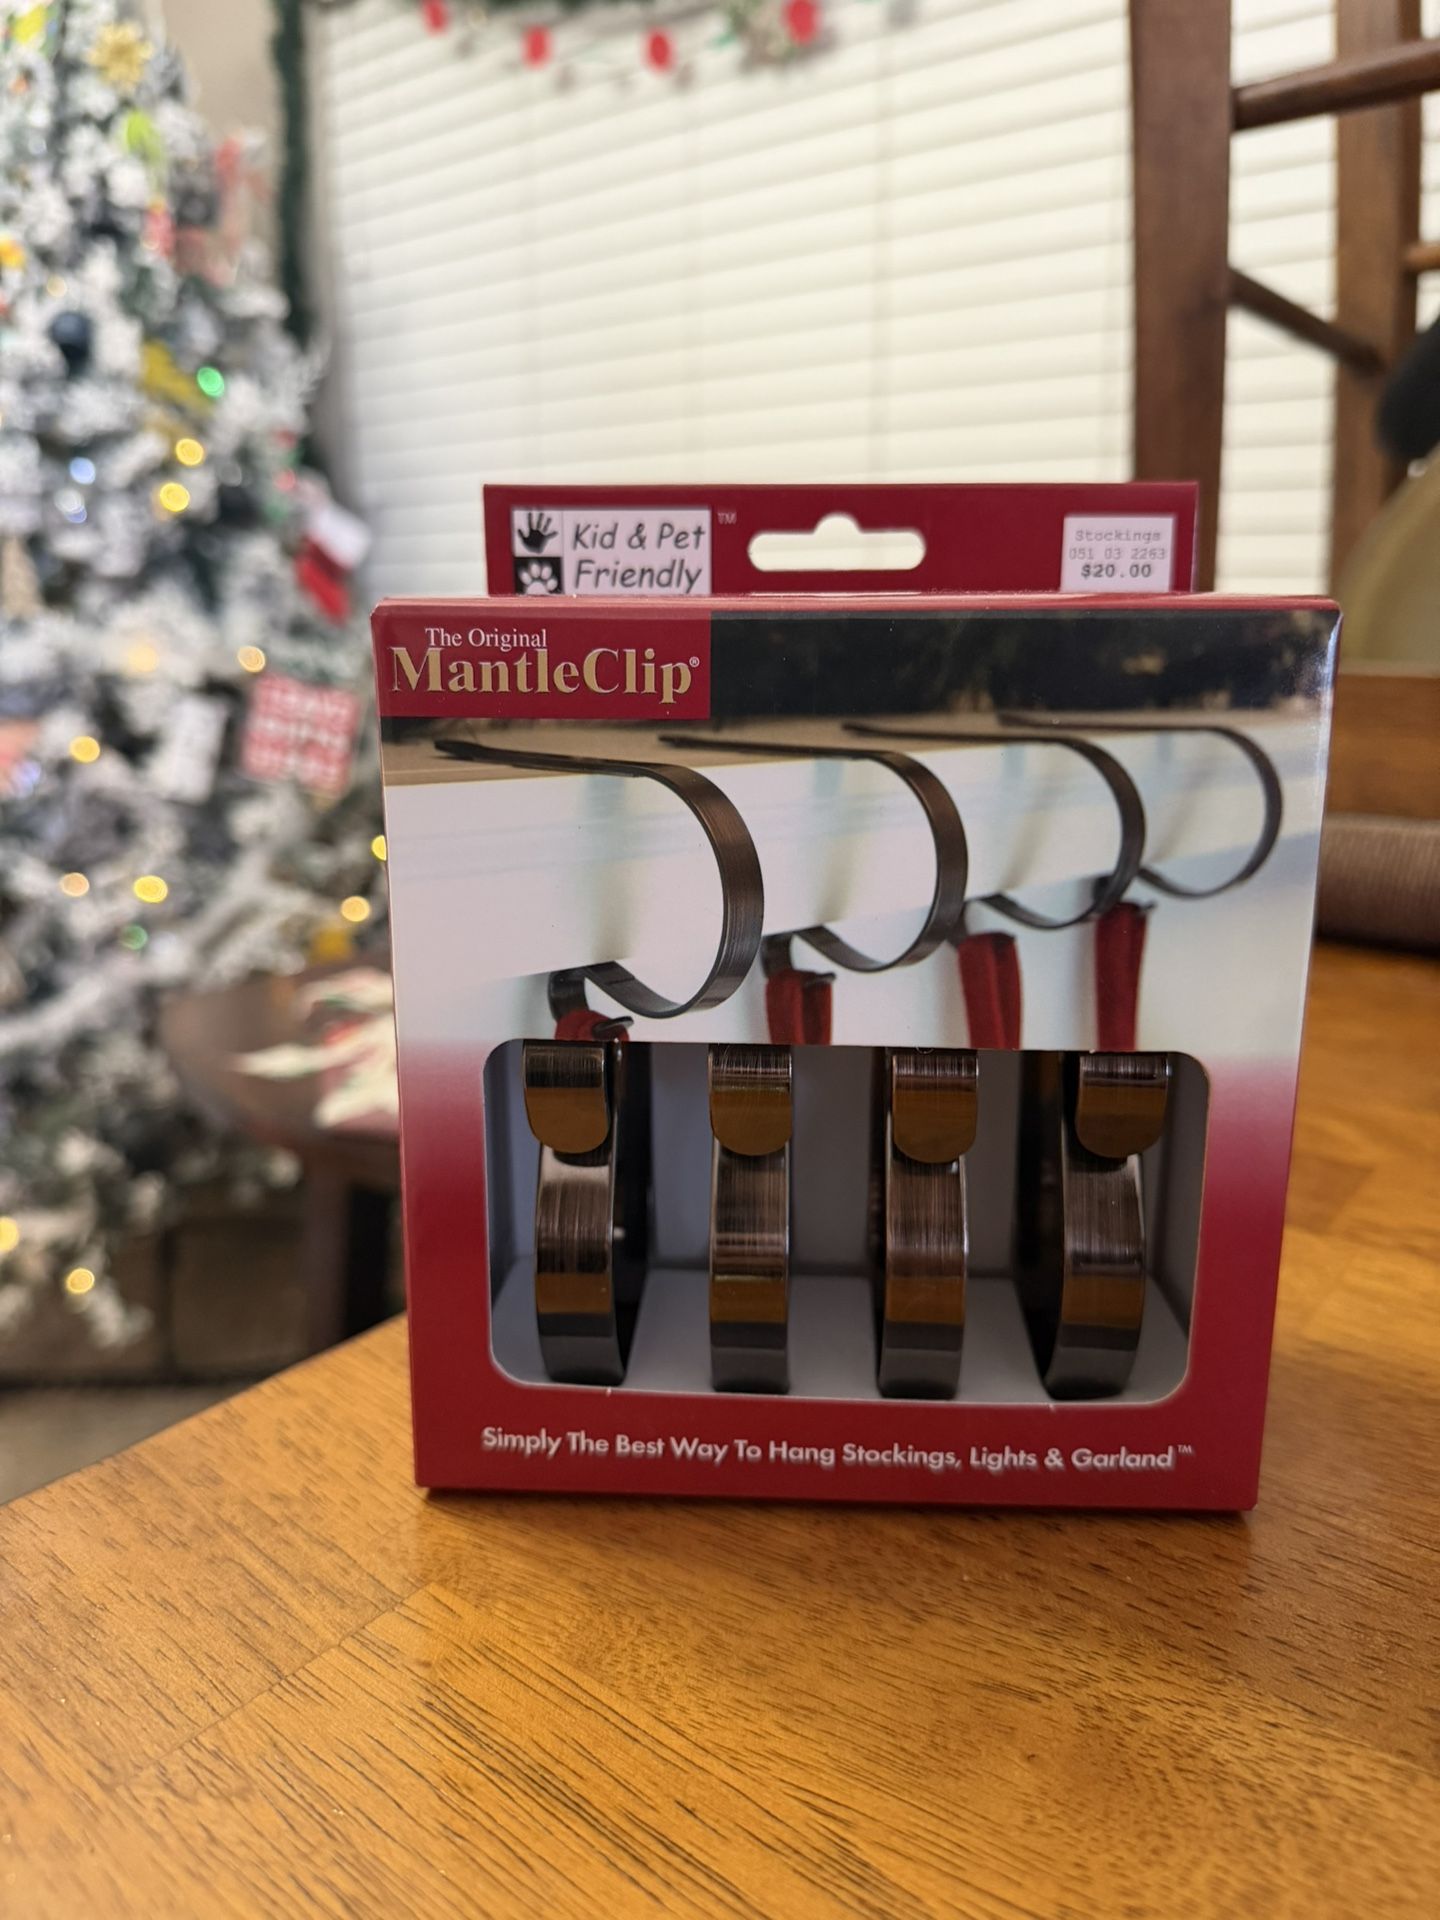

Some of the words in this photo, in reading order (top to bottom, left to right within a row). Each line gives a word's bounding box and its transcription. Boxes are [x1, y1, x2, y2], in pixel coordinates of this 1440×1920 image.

[572, 522, 618, 550] Kid
[627, 523, 646, 550] &
[657, 522, 705, 550] Pet
[1075, 529, 1161, 544] Stockings
[1069, 547, 1094, 560] 051
[1104, 547, 1122, 560] 03
[574, 558, 702, 594] Friendly
[1081, 563, 1152, 580] $20.00
[425, 627, 462, 646] The
[468, 628, 547, 652] Original
[482, 1427, 561, 1459] Simply
[568, 1431, 609, 1455] The
[615, 1434, 665, 1457] Best
[670, 1436, 728, 1465] Way
[734, 1438, 762, 1460] To
[769, 1440, 836, 1467] Hang
[842, 1443, 962, 1470] Stockings,
[969, 1445, 1038, 1473] Lights
[1044, 1447, 1064, 1469] &
